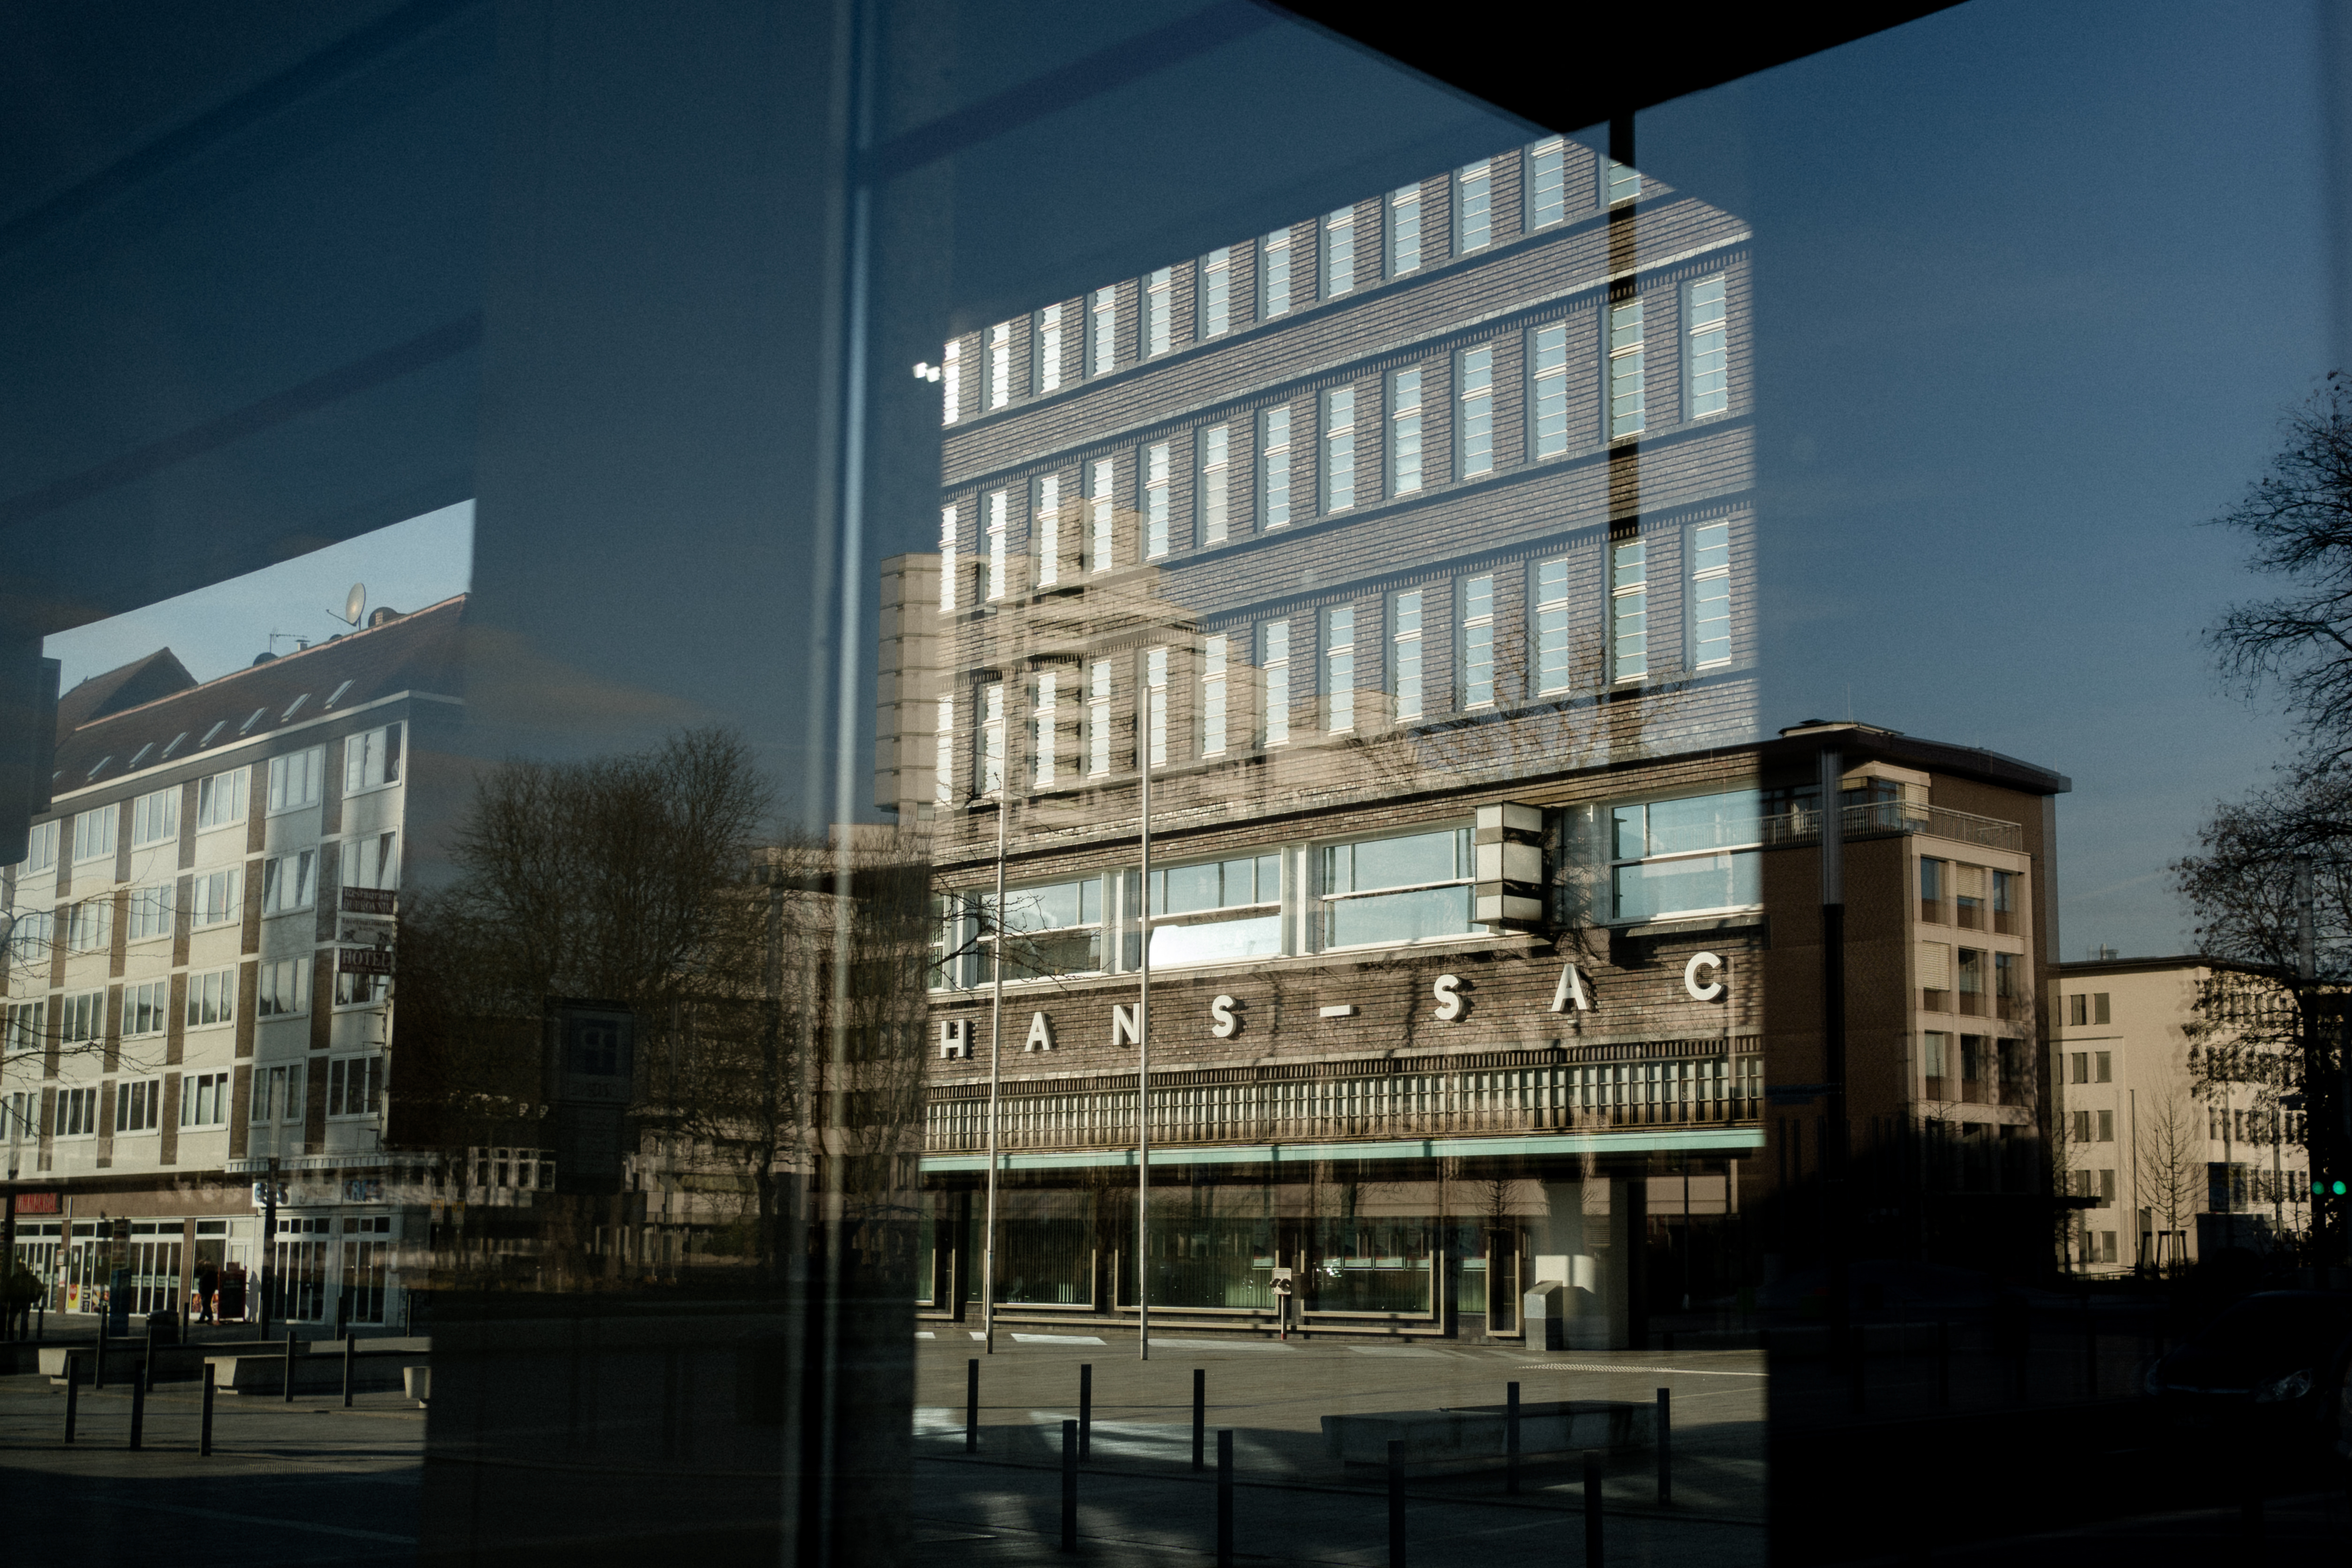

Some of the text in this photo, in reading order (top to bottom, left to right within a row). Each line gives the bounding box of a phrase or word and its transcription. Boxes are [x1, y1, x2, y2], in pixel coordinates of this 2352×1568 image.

[345, 889, 393, 900] Restaurant
[343, 899, 392, 913] DUBROVNIK
[342, 950, 390, 967] HOTEL
